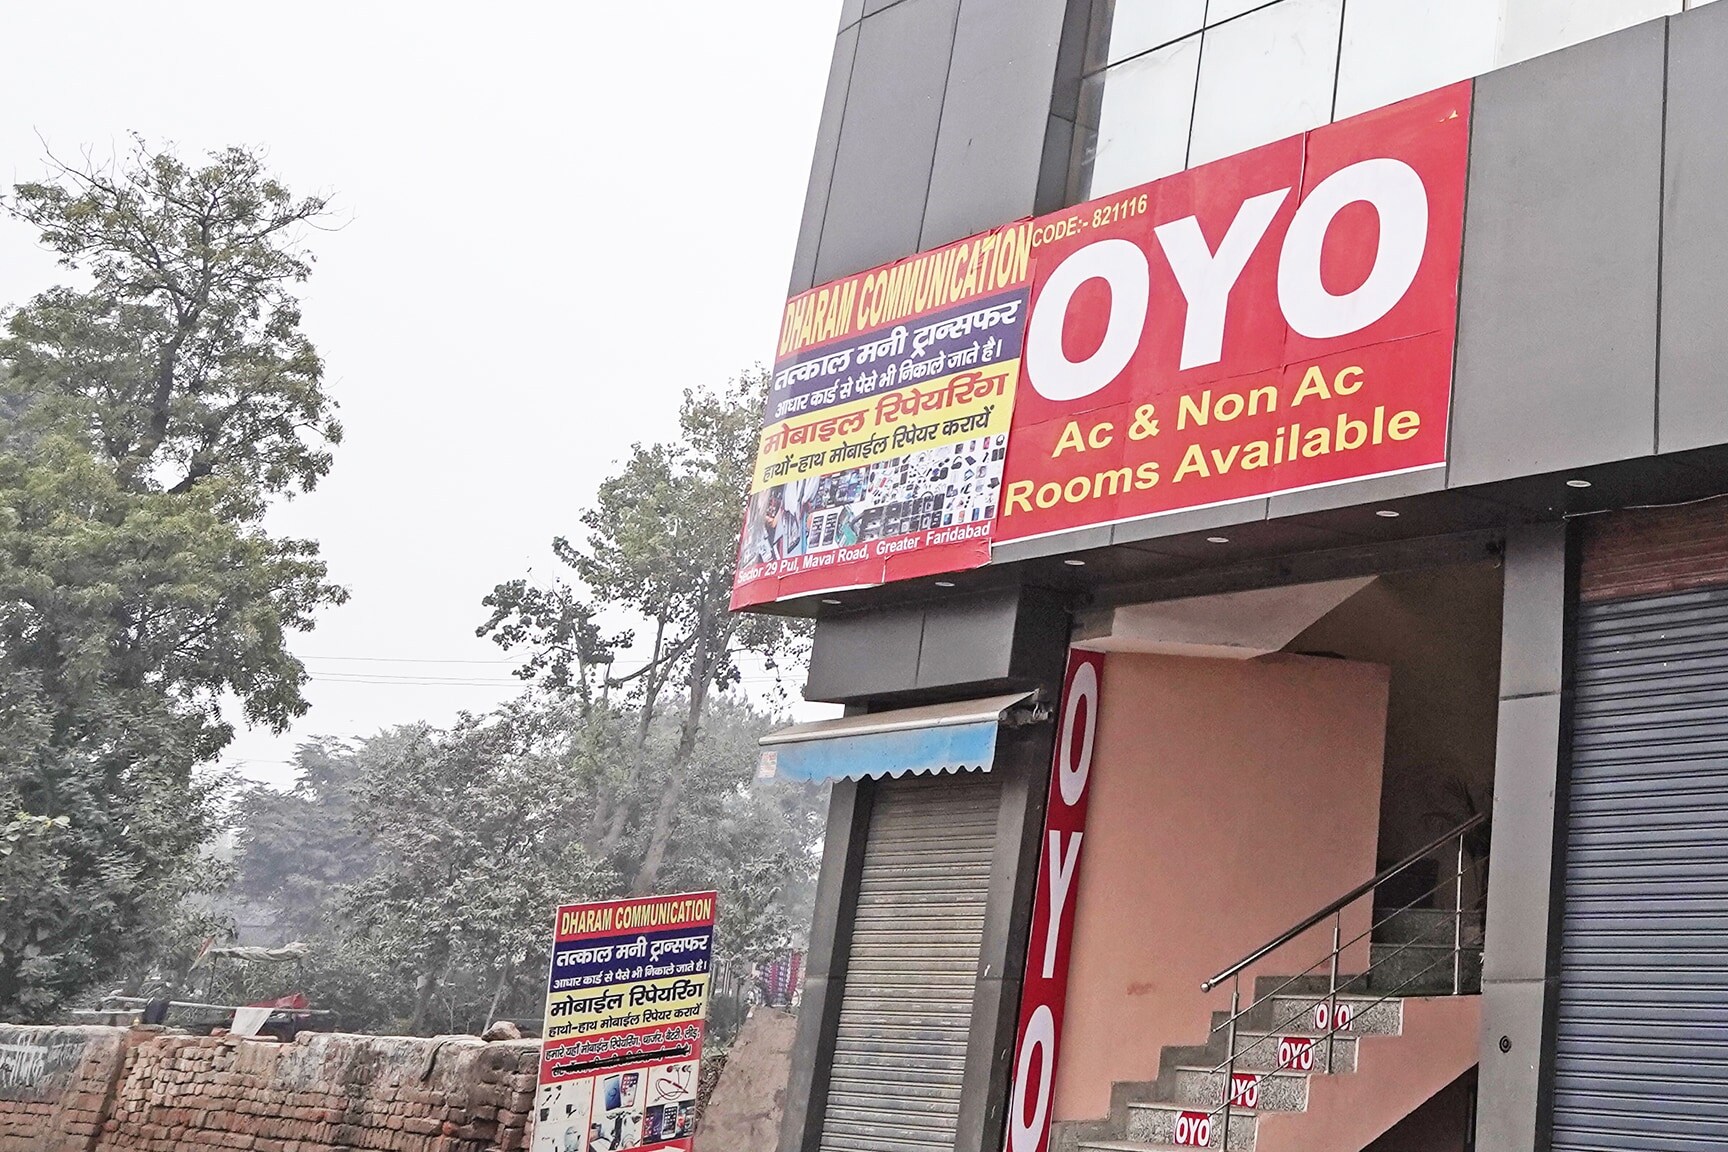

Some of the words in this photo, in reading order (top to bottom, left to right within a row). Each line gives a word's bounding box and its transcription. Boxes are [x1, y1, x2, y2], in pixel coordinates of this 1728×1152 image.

[1091, 193, 1148, 229] 821116
[779, 279, 859, 357] DHARAM
[857, 222, 1034, 331] COMMUNICATION
[1026, 157, 1429, 401] OYO
[774, 348, 855, 391] तत्काल
[856, 325, 908, 365] मनी
[910, 299, 1022, 359] ट्रान्सफर
[774, 393, 811, 419] आधार
[810, 379, 841, 407] कार्ड
[840, 376, 854, 400] से
[855, 369, 879, 394] पैसे
[878, 364, 898, 388] भी
[898, 350, 946, 384] निकाले
[948, 340, 981, 369] जाते
[763, 408, 868, 455] मोबाइल
[875, 371, 1009, 426] रिपेयरिंग
[829, 433, 889, 463] मोबाईल
[891, 422, 939, 450] रिपेयर
[943, 404, 995, 436] करायें
[1052, 419, 1113, 459] Ac
[1127, 403, 1160, 442] &
[1177, 385, 1278, 431] Non
[1291, 364, 1364, 408] Ac
[1003, 459, 1160, 518] Rooms
[1173, 406, 1421, 483] Available
[737, 562, 763, 584] Sector
[764, 561, 777, 576] 29
[802, 552, 835, 569] Mavai
[837, 545, 870, 564] Road,
[876, 537, 919, 556] Greater
[925, 521, 991, 546] Faridabad
[561, 908, 613, 935] DHARAM
[615, 899, 712, 930] COMMUNICATION
[1010, 661, 1098, 1152] OYO
[553, 977, 584, 989] आधार
[583, 971, 603, 985] कार्ड
[604, 970, 613, 983] से
[615, 967, 630, 981] पैसे
[631, 967, 643, 980] भी
[644, 963, 675, 978] निकाले
[676, 961, 695, 973] जाते
[556, 946, 614, 967] तत्काल
[616, 936, 647, 960] मनी
[650, 935, 709, 962] ट्रान्सफर
[550, 989, 624, 1017] मोबाईल
[629, 979, 705, 1007] रिपेयरिंग
[1315, 1004, 1350, 1030] OO
[1278, 1042, 1313, 1069] OYO
[1175, 1117, 1210, 1145] OYO
